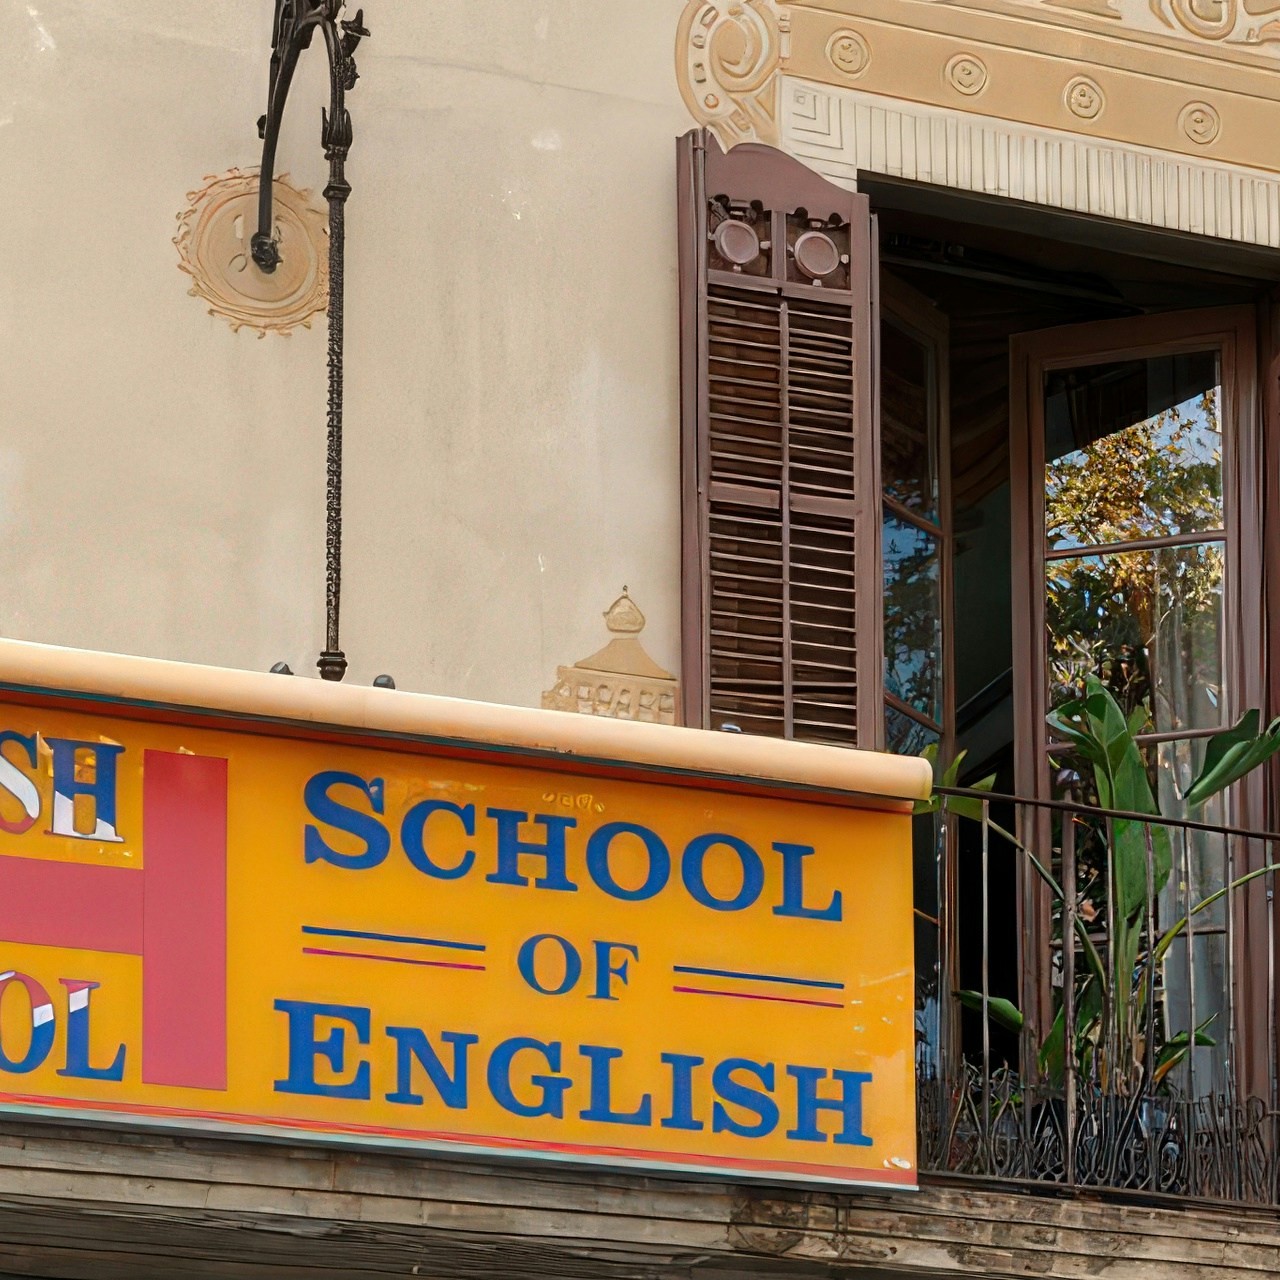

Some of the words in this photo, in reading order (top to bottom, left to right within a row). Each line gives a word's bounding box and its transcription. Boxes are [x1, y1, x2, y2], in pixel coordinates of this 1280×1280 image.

[303, 770, 843, 921] SCHOOL
[517, 933, 639, 1000] OF
[273, 999, 873, 1146] ENGLISH
